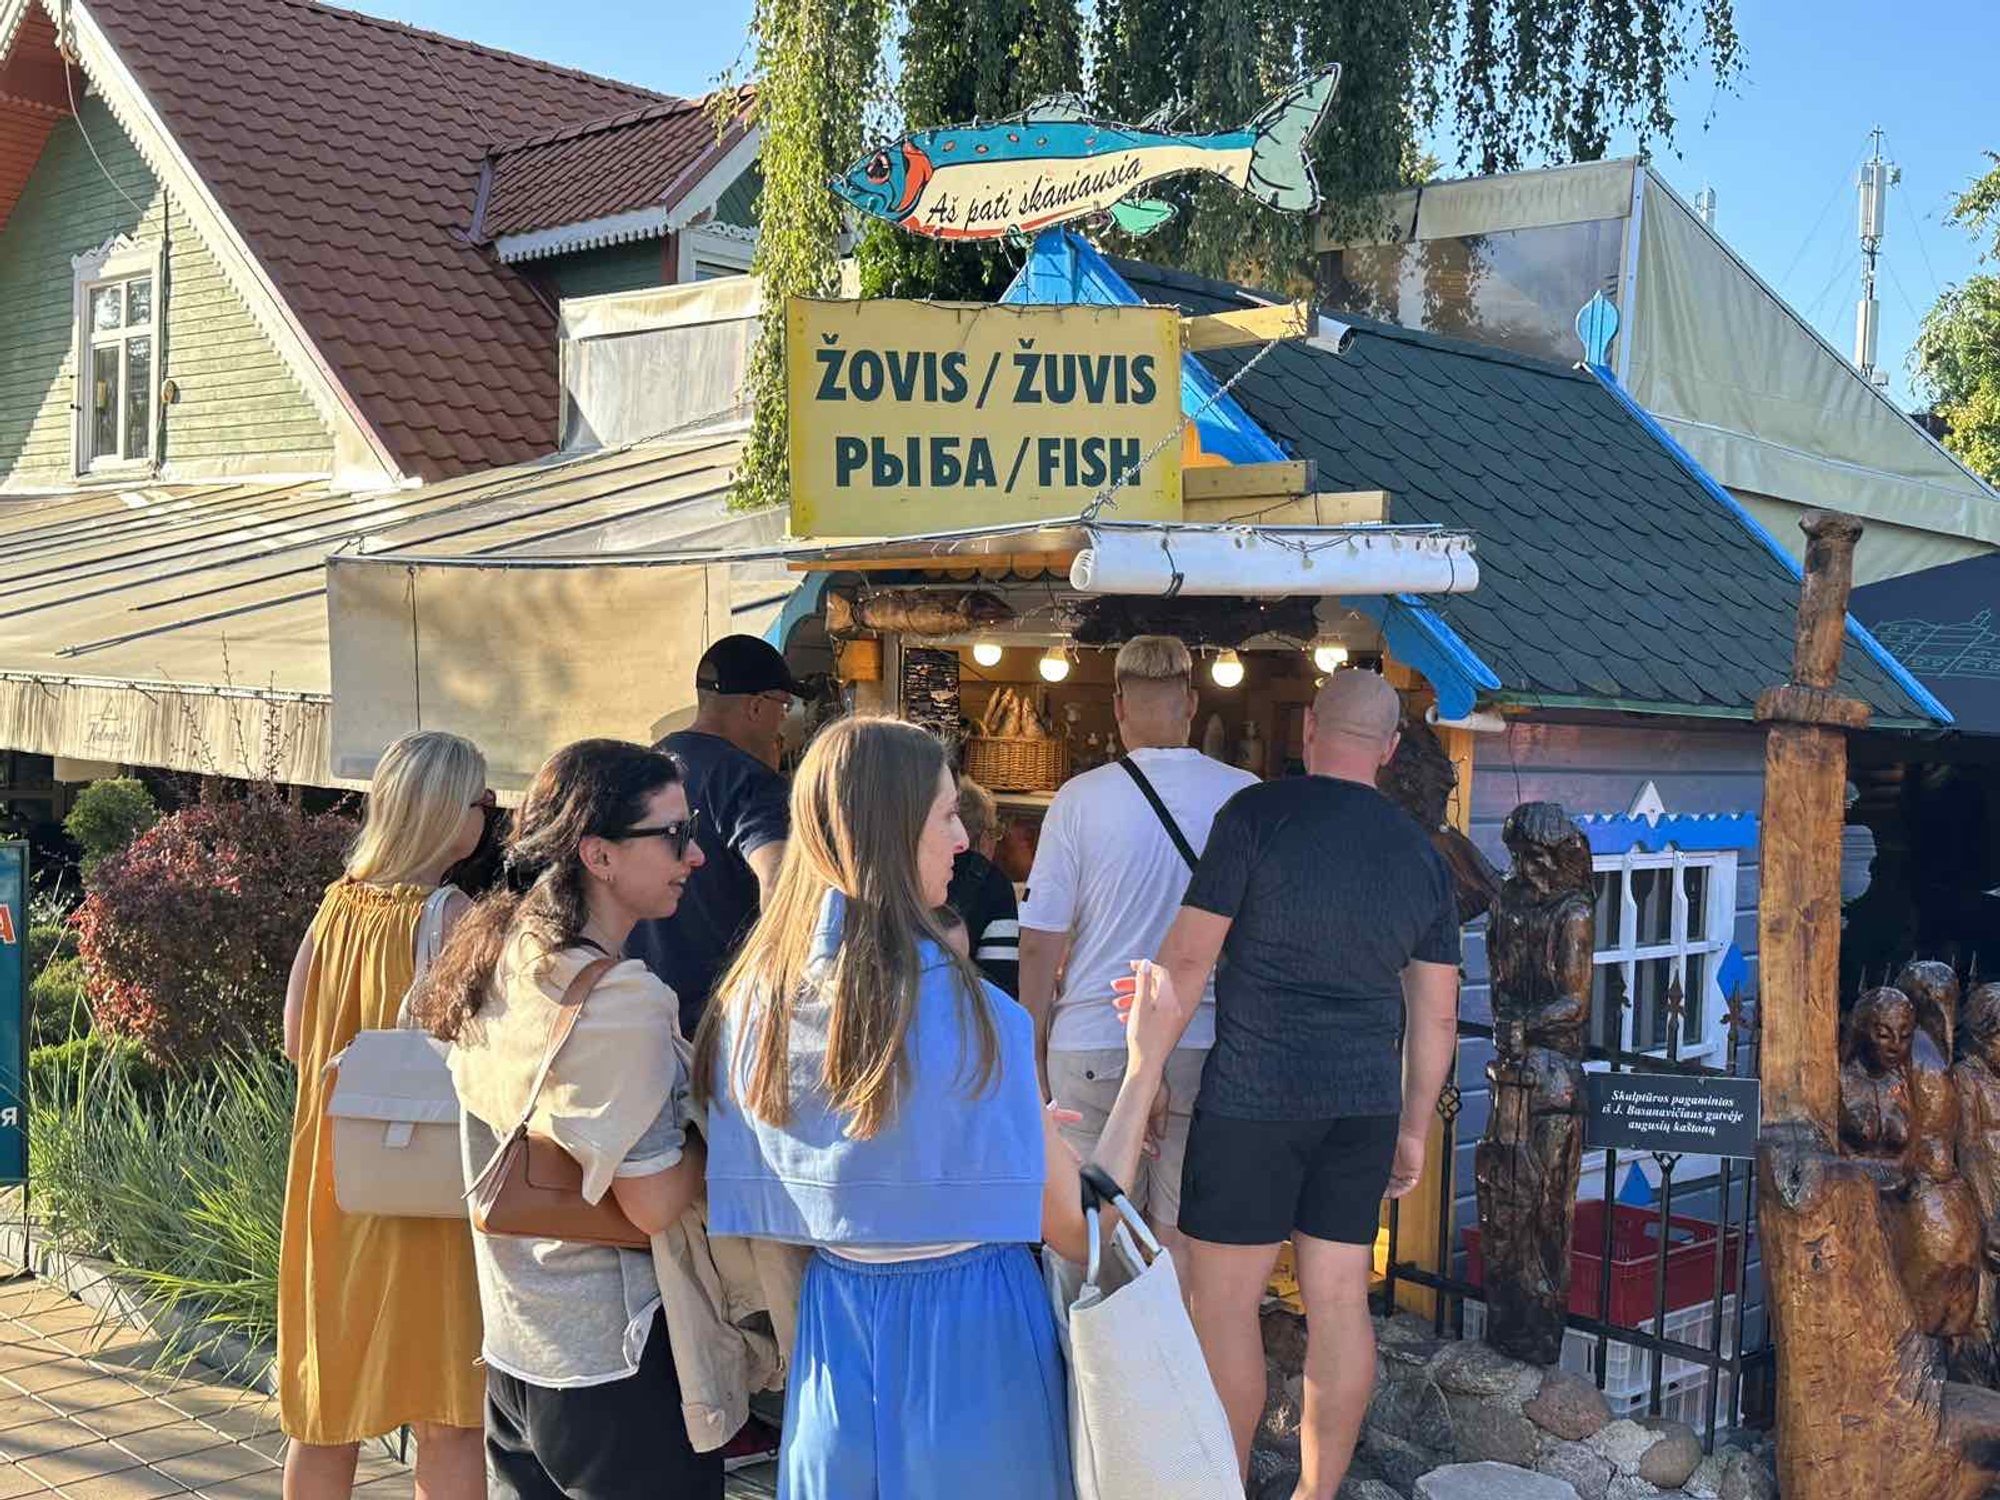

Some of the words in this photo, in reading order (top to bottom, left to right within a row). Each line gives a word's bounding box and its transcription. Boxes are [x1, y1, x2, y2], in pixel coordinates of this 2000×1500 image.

[926, 192, 959, 224] Aš
[963, 188, 1012, 234] pati
[1018, 154, 1143, 216] skaniausia
[815, 332, 969, 403] ŽOVIS
[1012, 337, 1157, 405] ŽUVIS
[835, 436, 998, 488] РЫБА
[1037, 436, 1142, 488] FISH
[1611, 1089, 1670, 1105] Skulptūros
[1613, 1103, 1623, 1115] J.
[1626, 1104, 1703, 1119] Basanavičiaus
[1704, 1109, 1744, 1124] gatvėje
[1628, 1120, 1670, 1134] augusių
[1672, 1121, 1717, 1136] kaštonų
